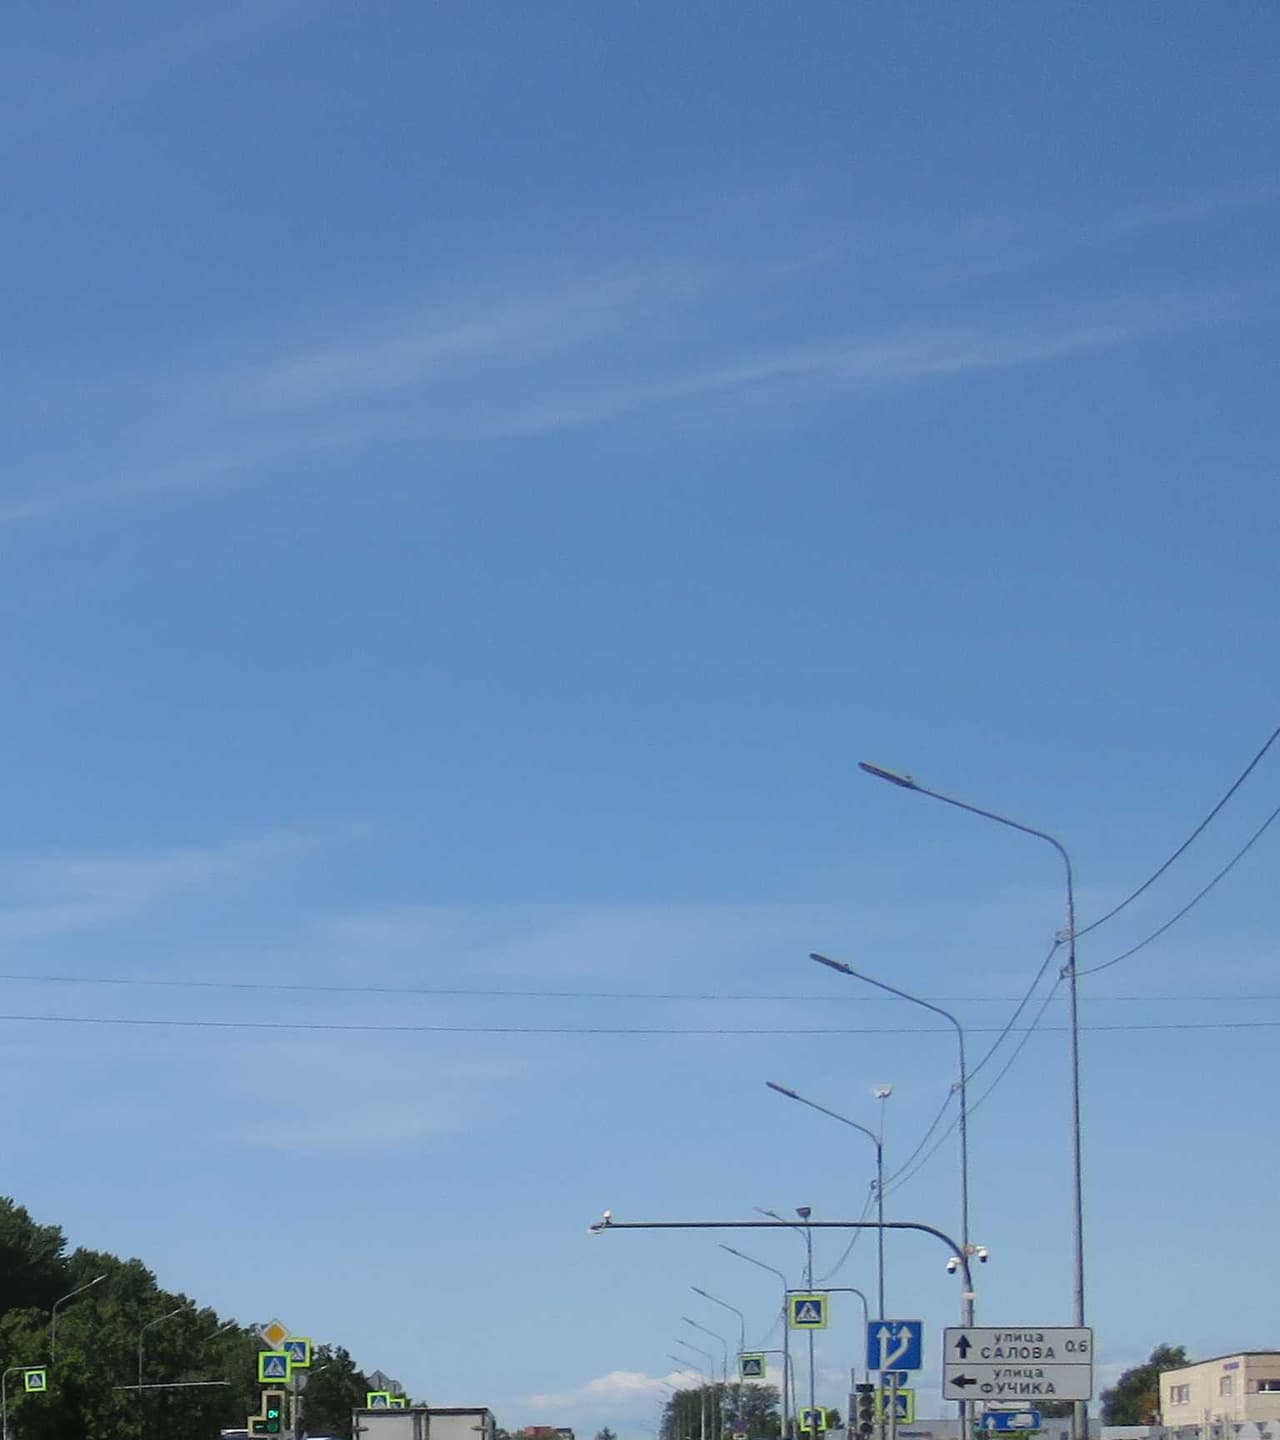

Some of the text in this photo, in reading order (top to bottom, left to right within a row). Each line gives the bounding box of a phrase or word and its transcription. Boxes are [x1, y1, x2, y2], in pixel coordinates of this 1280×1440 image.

[993, 1333, 1044, 1345] улица
[980, 1347, 1056, 1359] САЛОВА
[993, 1368, 1044, 1380] улица
[980, 1383, 1056, 1395] ФУЧИКА
